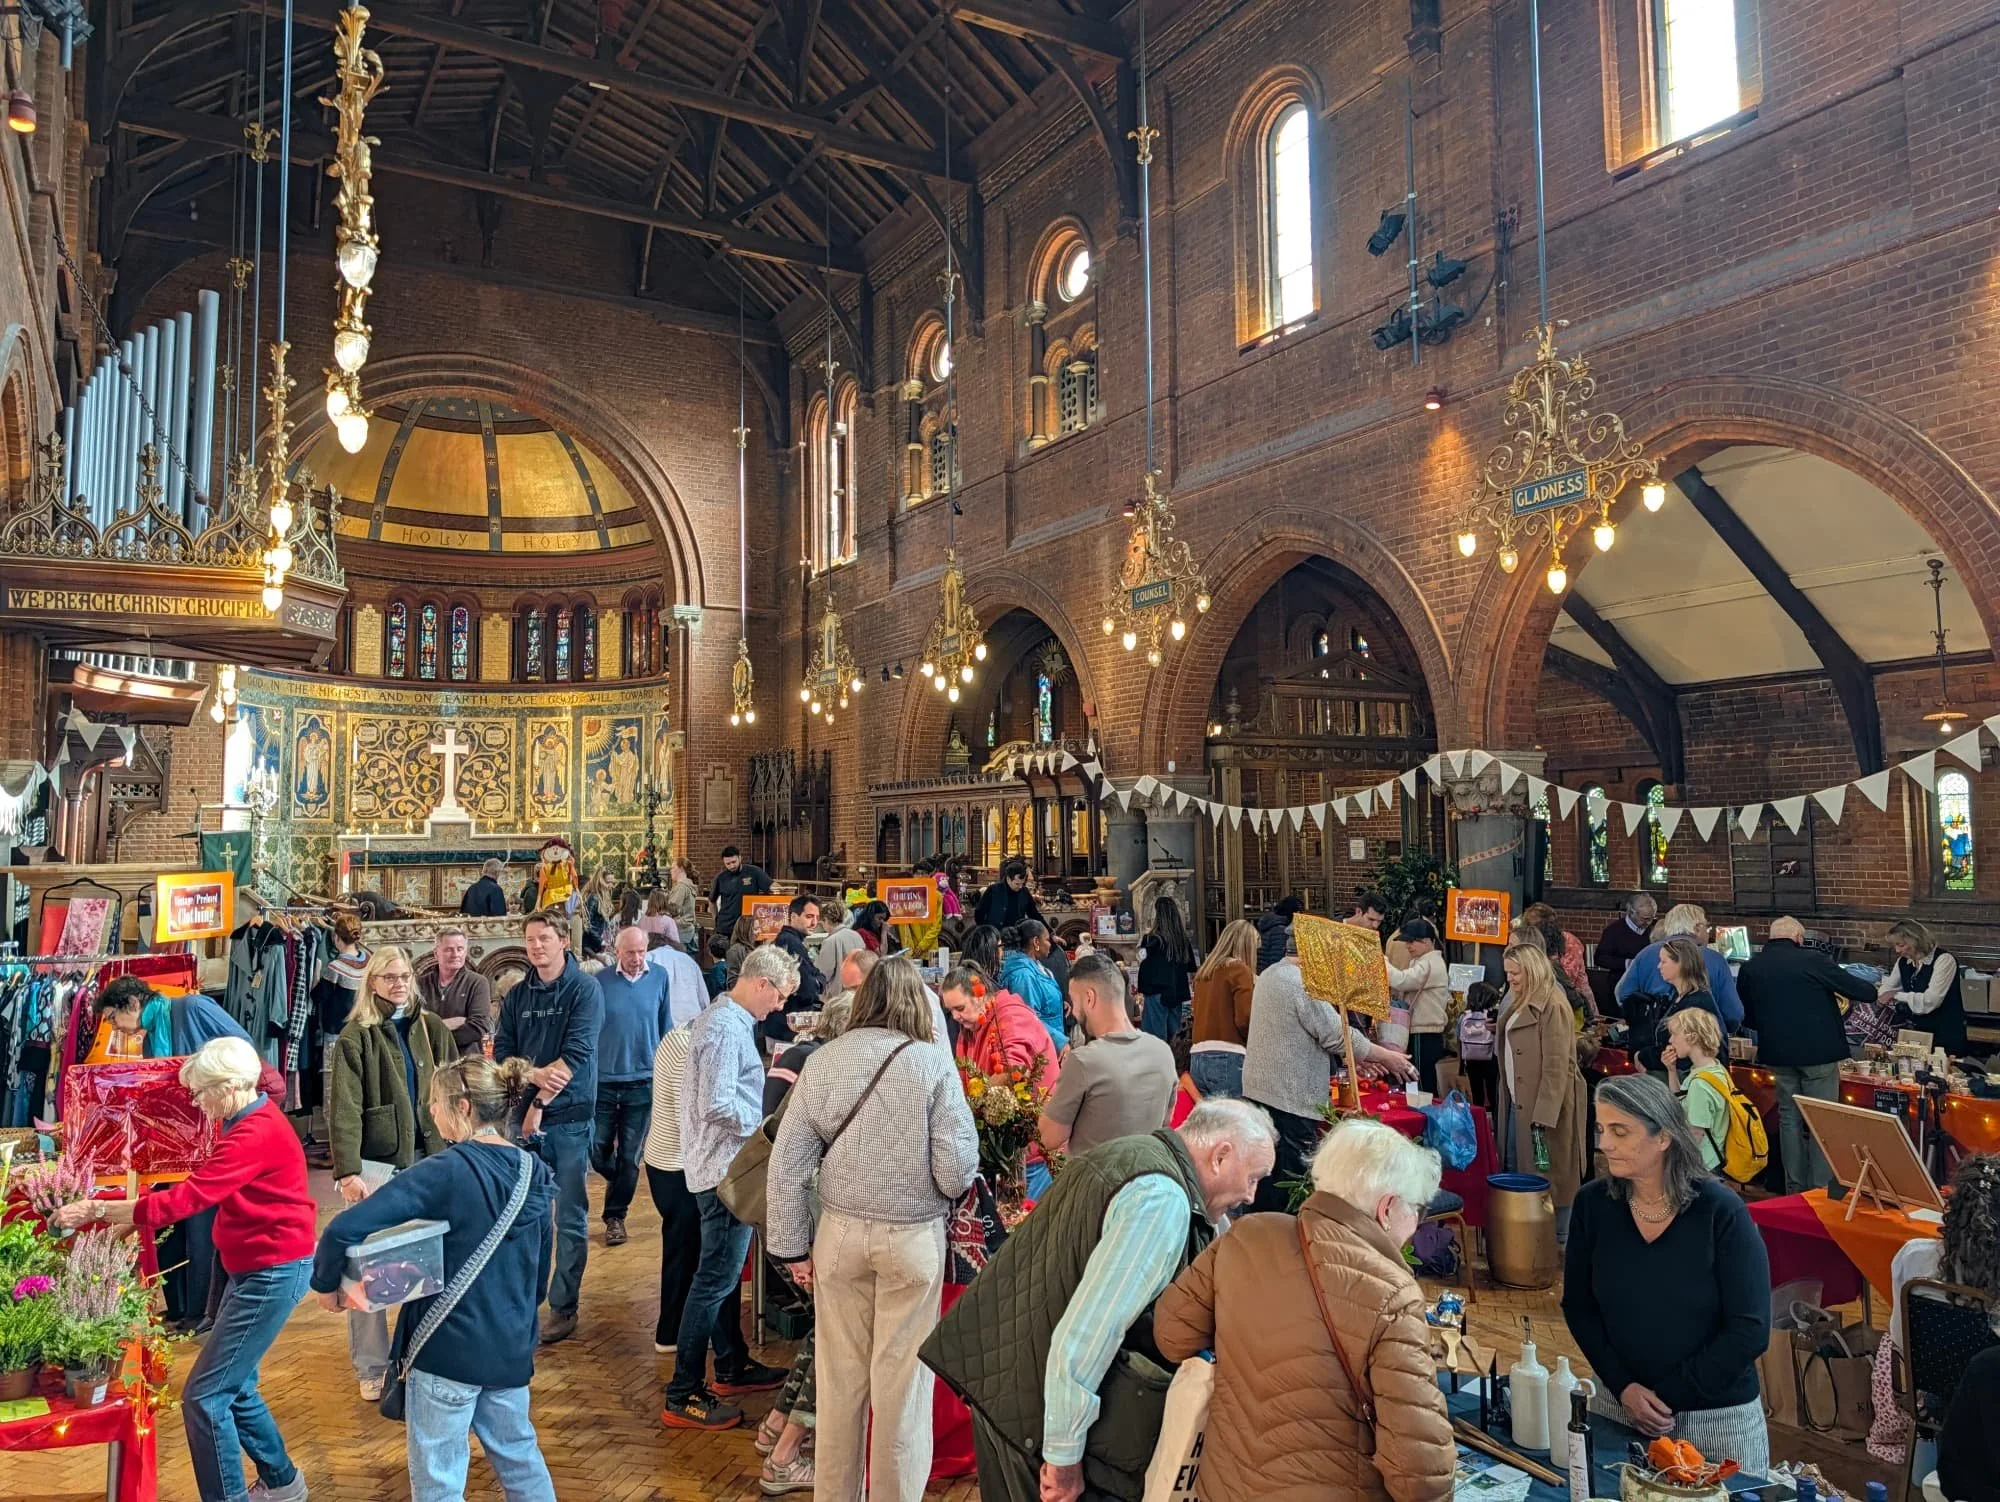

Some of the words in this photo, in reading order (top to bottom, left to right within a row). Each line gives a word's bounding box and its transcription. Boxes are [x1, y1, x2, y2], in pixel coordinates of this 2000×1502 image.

[1516, 475, 1584, 508] GLADNESS
[402, 528, 468, 546] HOLY
[1135, 584, 1168, 603] COUNSEL
[247, 676, 264, 689] GOD
[270, 679, 280, 691] IN
[288, 683, 308, 695] THE
[379, 691, 404, 702] AND
[414, 693, 432, 703] ON
[445, 694, 488, 705] EARTH
[500, 695, 537, 705] PEACE
[547, 694, 579, 705] GOOD
[588, 693, 613, 702] WILL
[620, 689, 654, 701] TOWARD
[1852, 1019, 1877, 1034] JUST
[685, 1405, 707, 1420] HOKA
